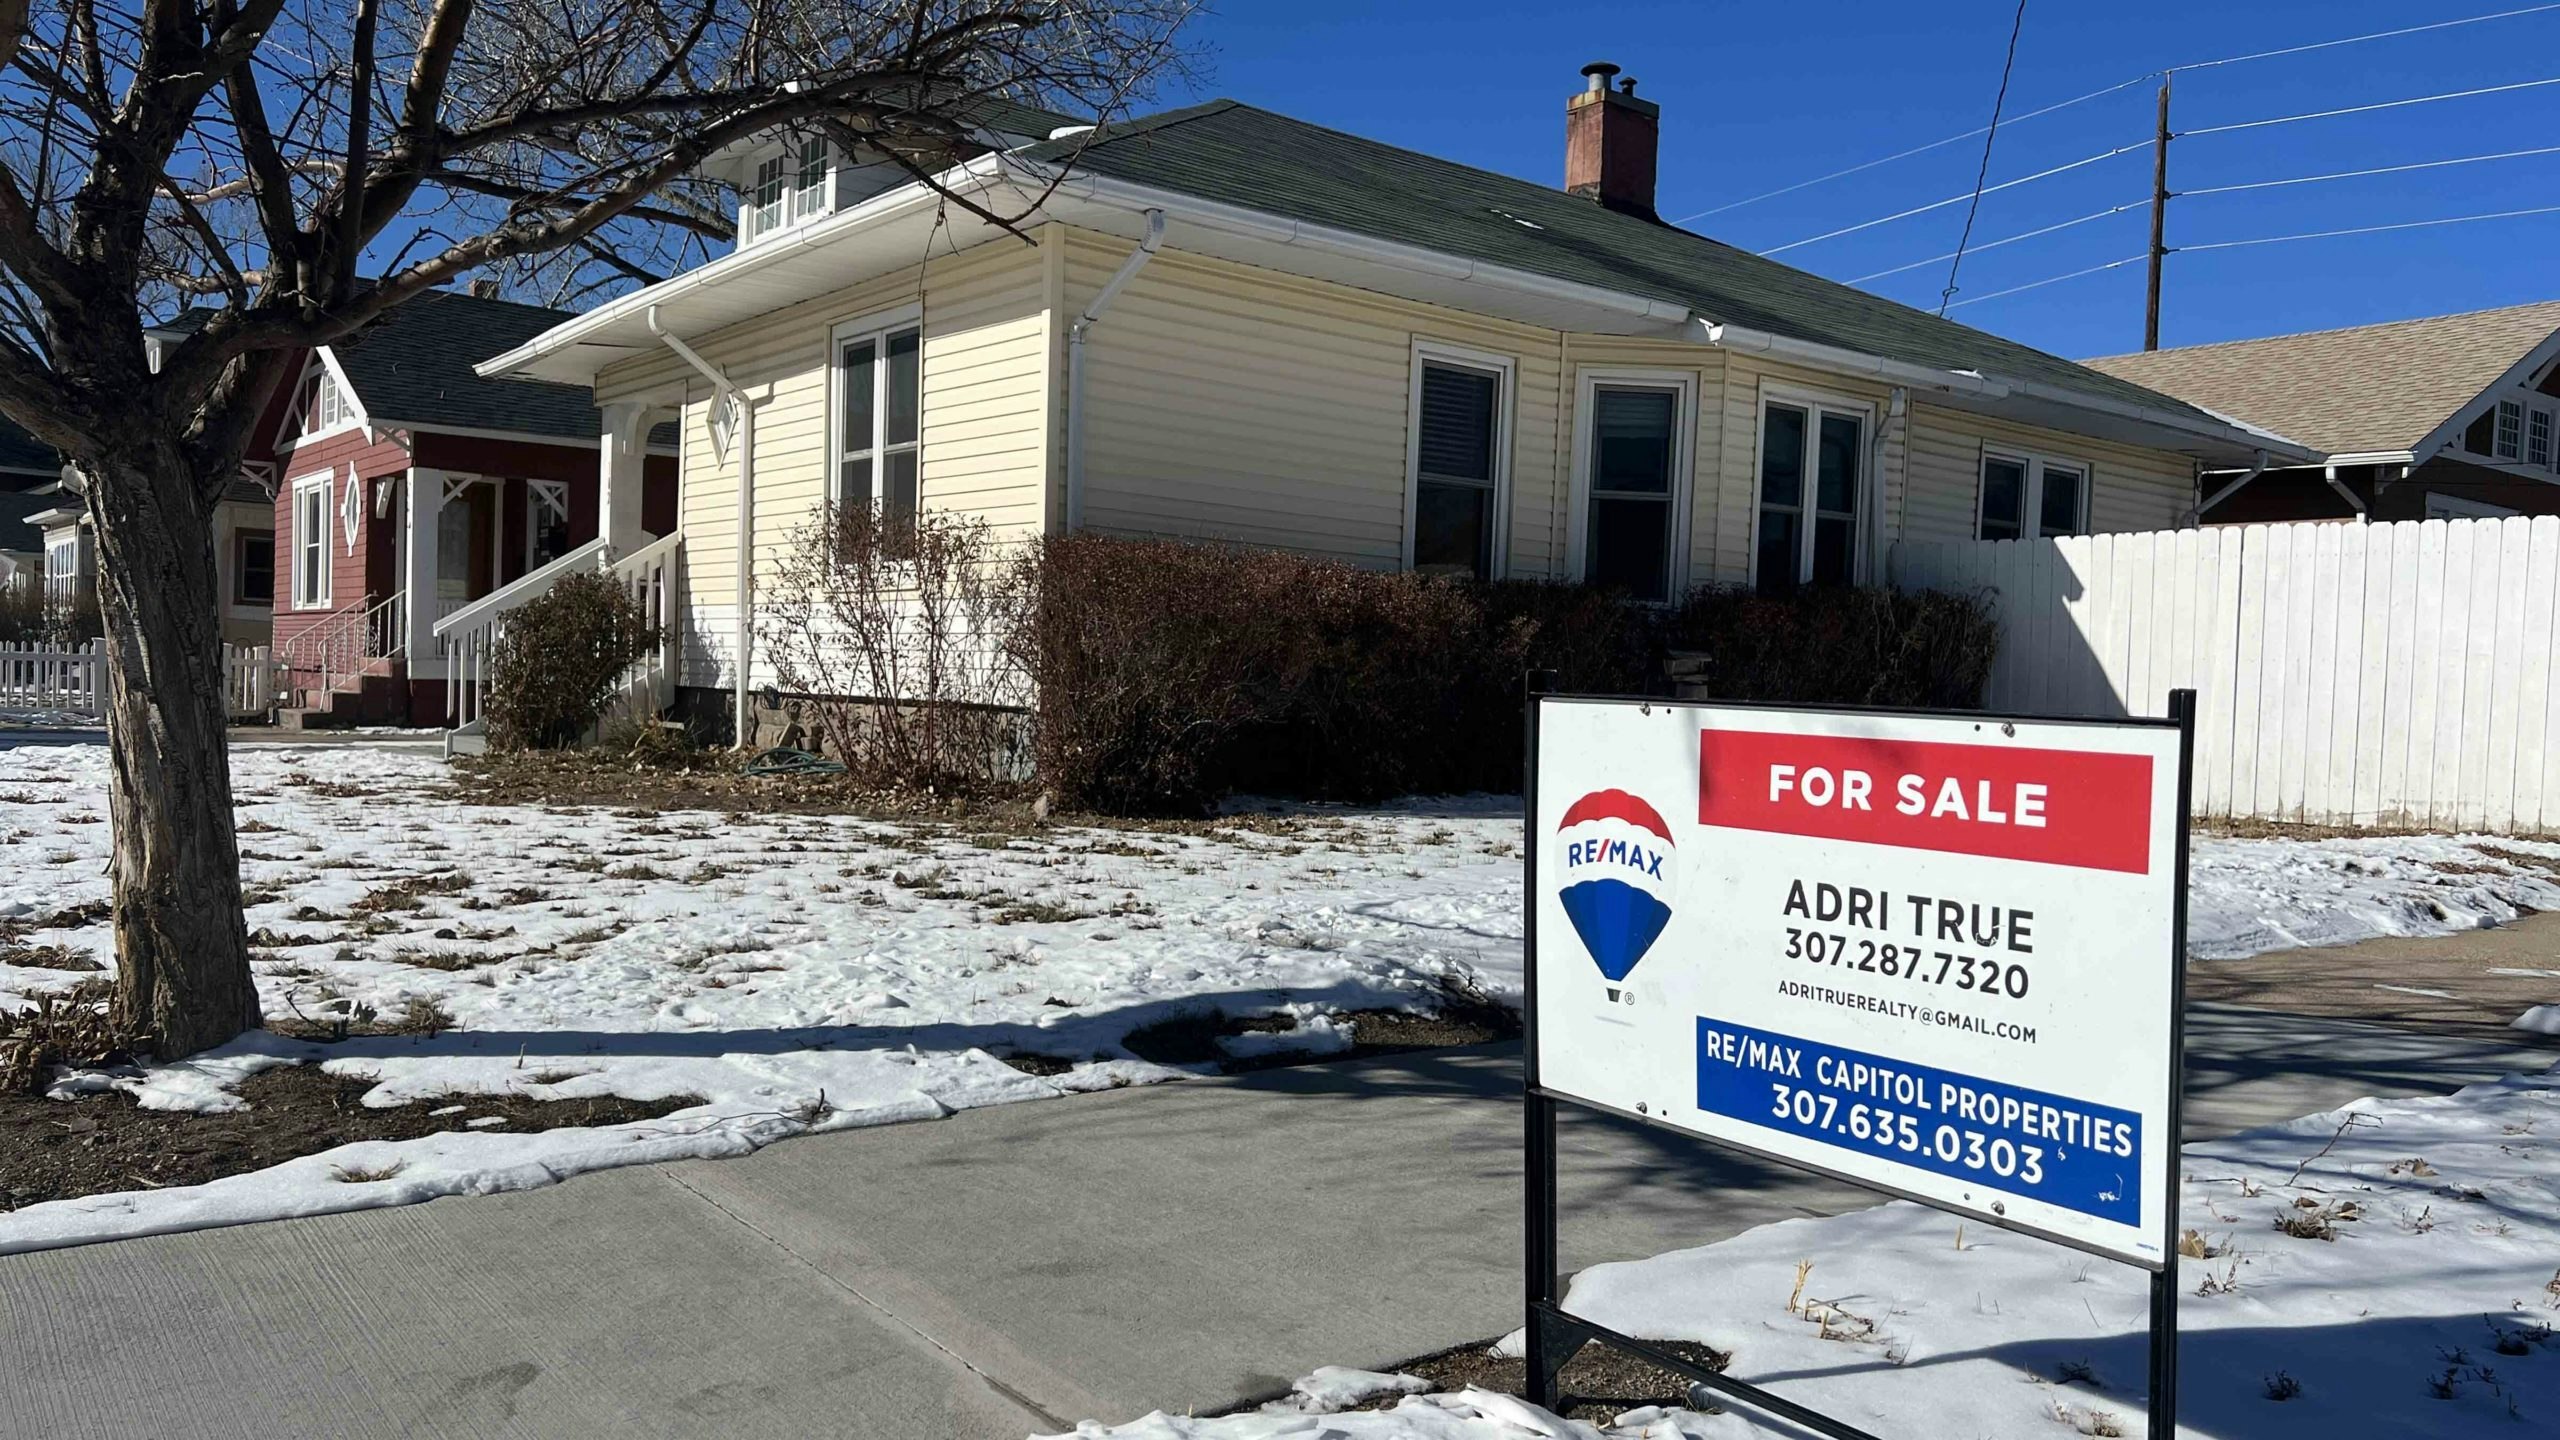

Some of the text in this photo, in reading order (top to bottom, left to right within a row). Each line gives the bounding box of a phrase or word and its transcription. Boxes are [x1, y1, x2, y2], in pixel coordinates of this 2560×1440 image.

[1769, 764, 2048, 828] FOR SALE
[1568, 838, 1664, 882] RE/MAX
[1783, 878, 2035, 954] ADRI TRUE
[1784, 927, 2030, 1000] 307.287.7320
[1778, 980, 2037, 1044] ADRITRUEREALTY@GMAIL.COM
[1706, 1029, 2132, 1158] RE/MAX CAPITOL PROPERTIES
[1771, 1083, 2044, 1185] 307.635.0303
